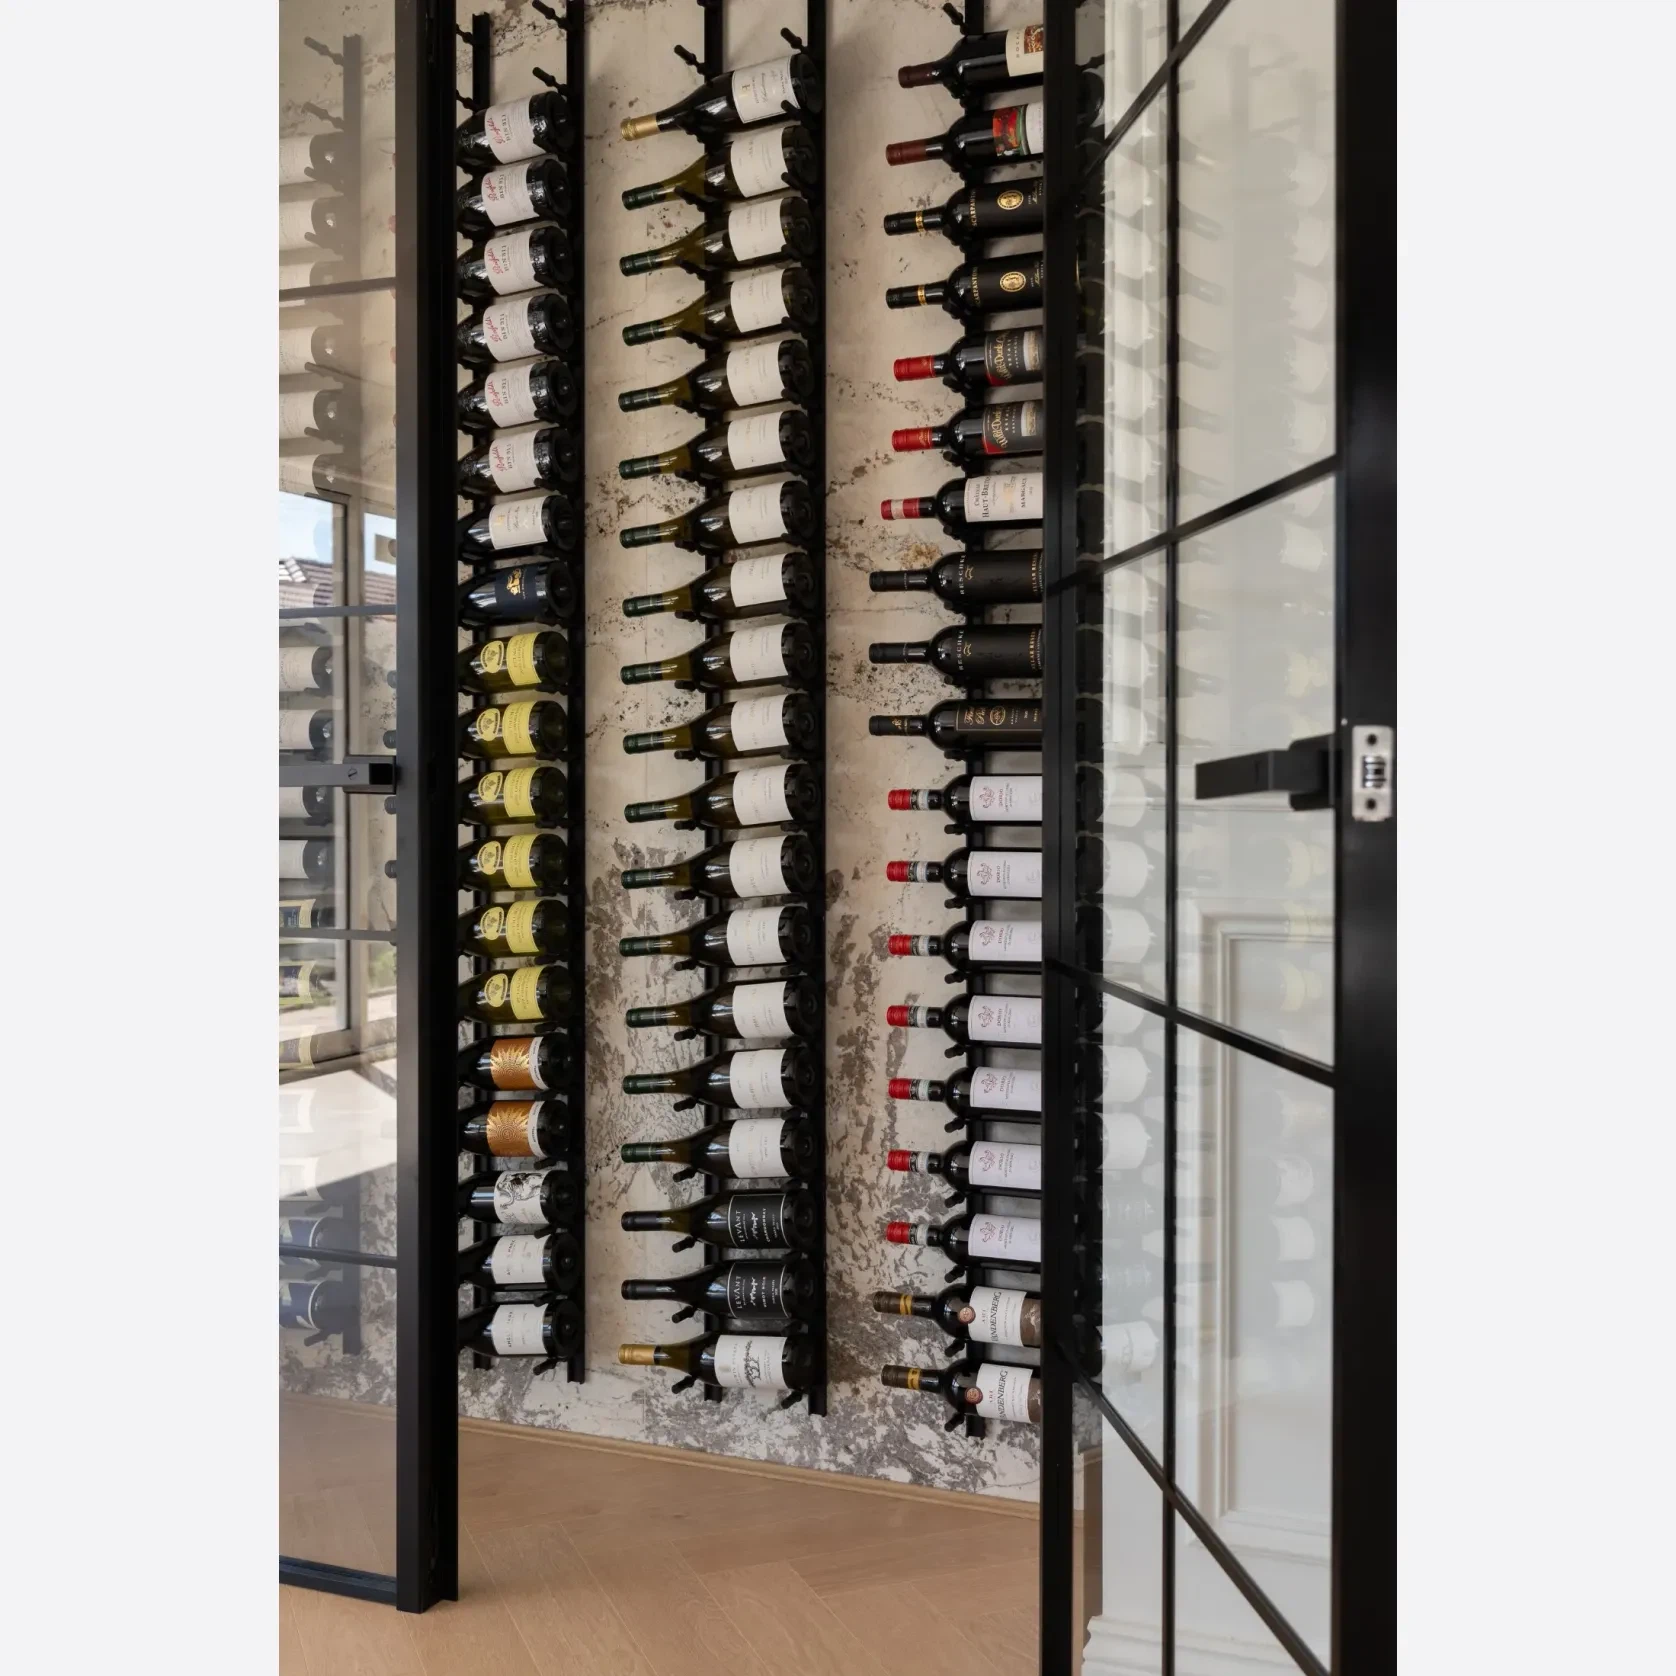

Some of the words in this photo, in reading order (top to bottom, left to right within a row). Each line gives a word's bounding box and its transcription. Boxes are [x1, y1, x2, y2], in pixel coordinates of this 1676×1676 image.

[994, 344, 1004, 365] Duck
[992, 429, 1008, 448] Wild
[735, 1210, 746, 1242] LEVANT
[762, 1208, 770, 1242] CHARDONNAY
